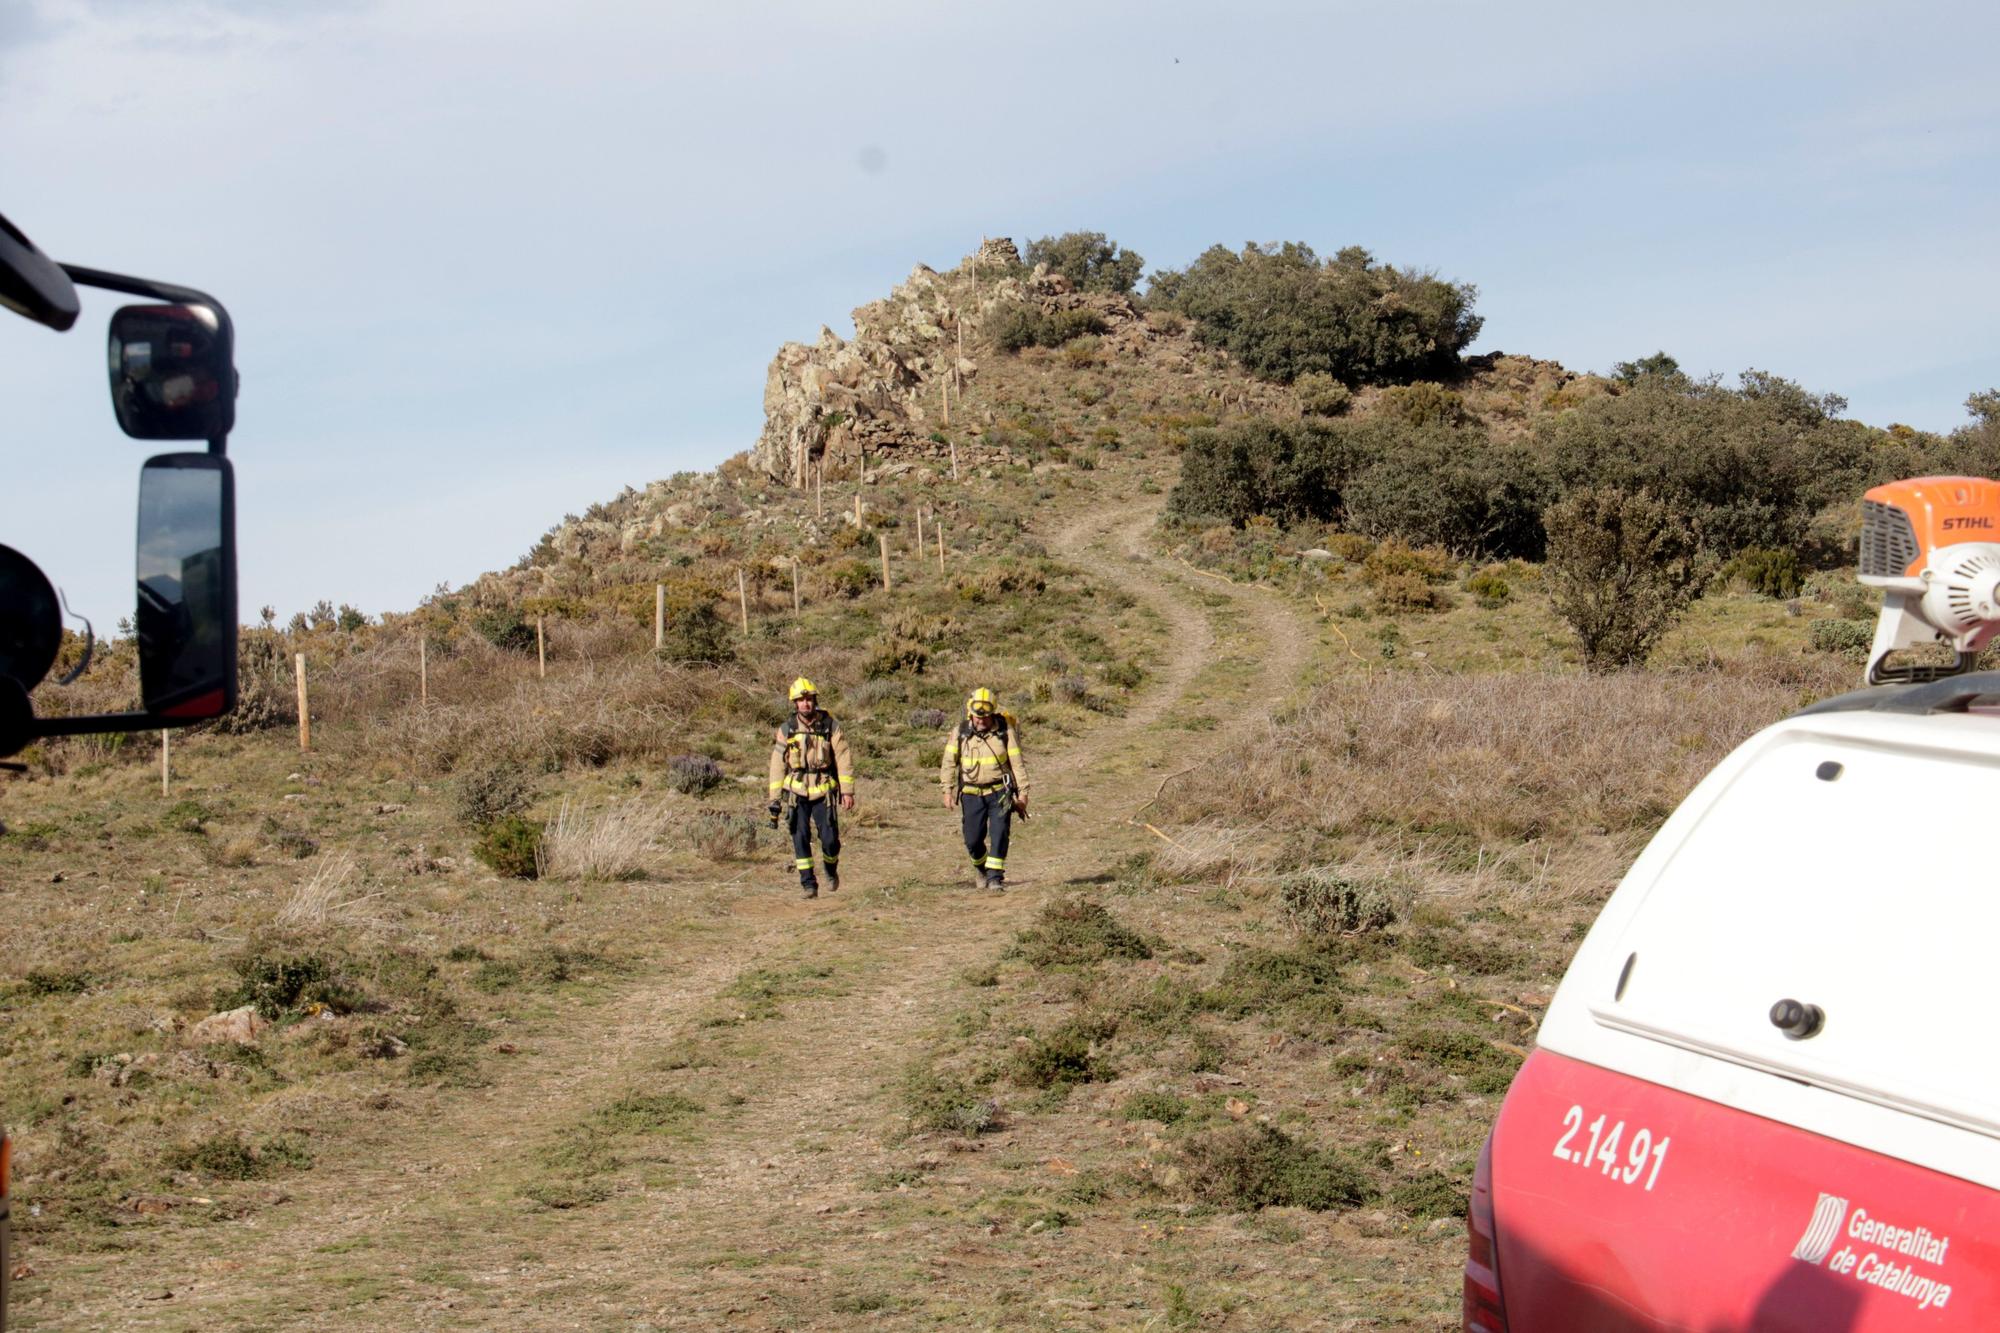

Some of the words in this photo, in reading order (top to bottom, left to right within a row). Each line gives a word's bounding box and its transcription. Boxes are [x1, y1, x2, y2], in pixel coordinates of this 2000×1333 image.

[1942, 517, 1993, 530] STIHL
[1553, 1105, 1671, 1190] 2.14.91
[1848, 1208, 1948, 1265] Generalitat
[1829, 1245, 1855, 1274] de
[1856, 1252, 1952, 1310] Catalunya
